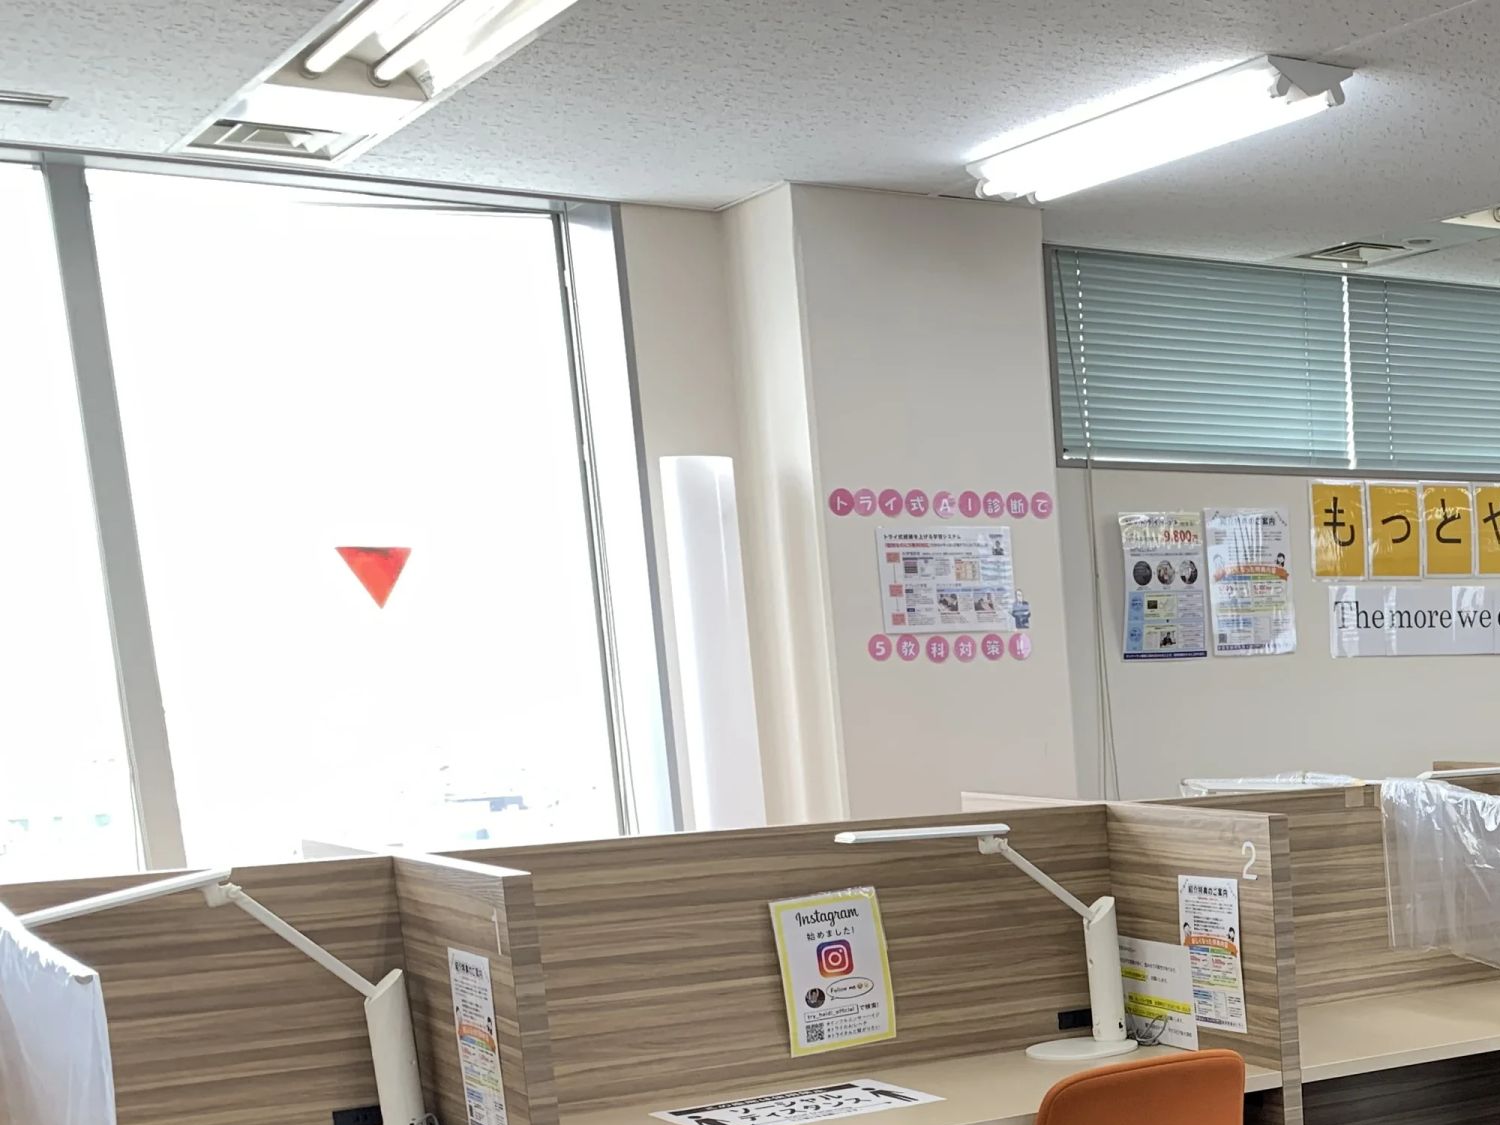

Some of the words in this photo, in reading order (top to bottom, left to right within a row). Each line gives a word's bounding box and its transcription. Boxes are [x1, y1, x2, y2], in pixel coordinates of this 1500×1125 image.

[1333, 600, 1385, 629] The
[1389, 609, 1452, 629] more
[1457, 609, 1492, 628] we
[1241, 841, 1258, 880] 2
[795, 908, 860, 928] Instagram
[730, 1094, 843, 1114] ソーシャル
[738, 1097, 872, 1122] ディスタンス
